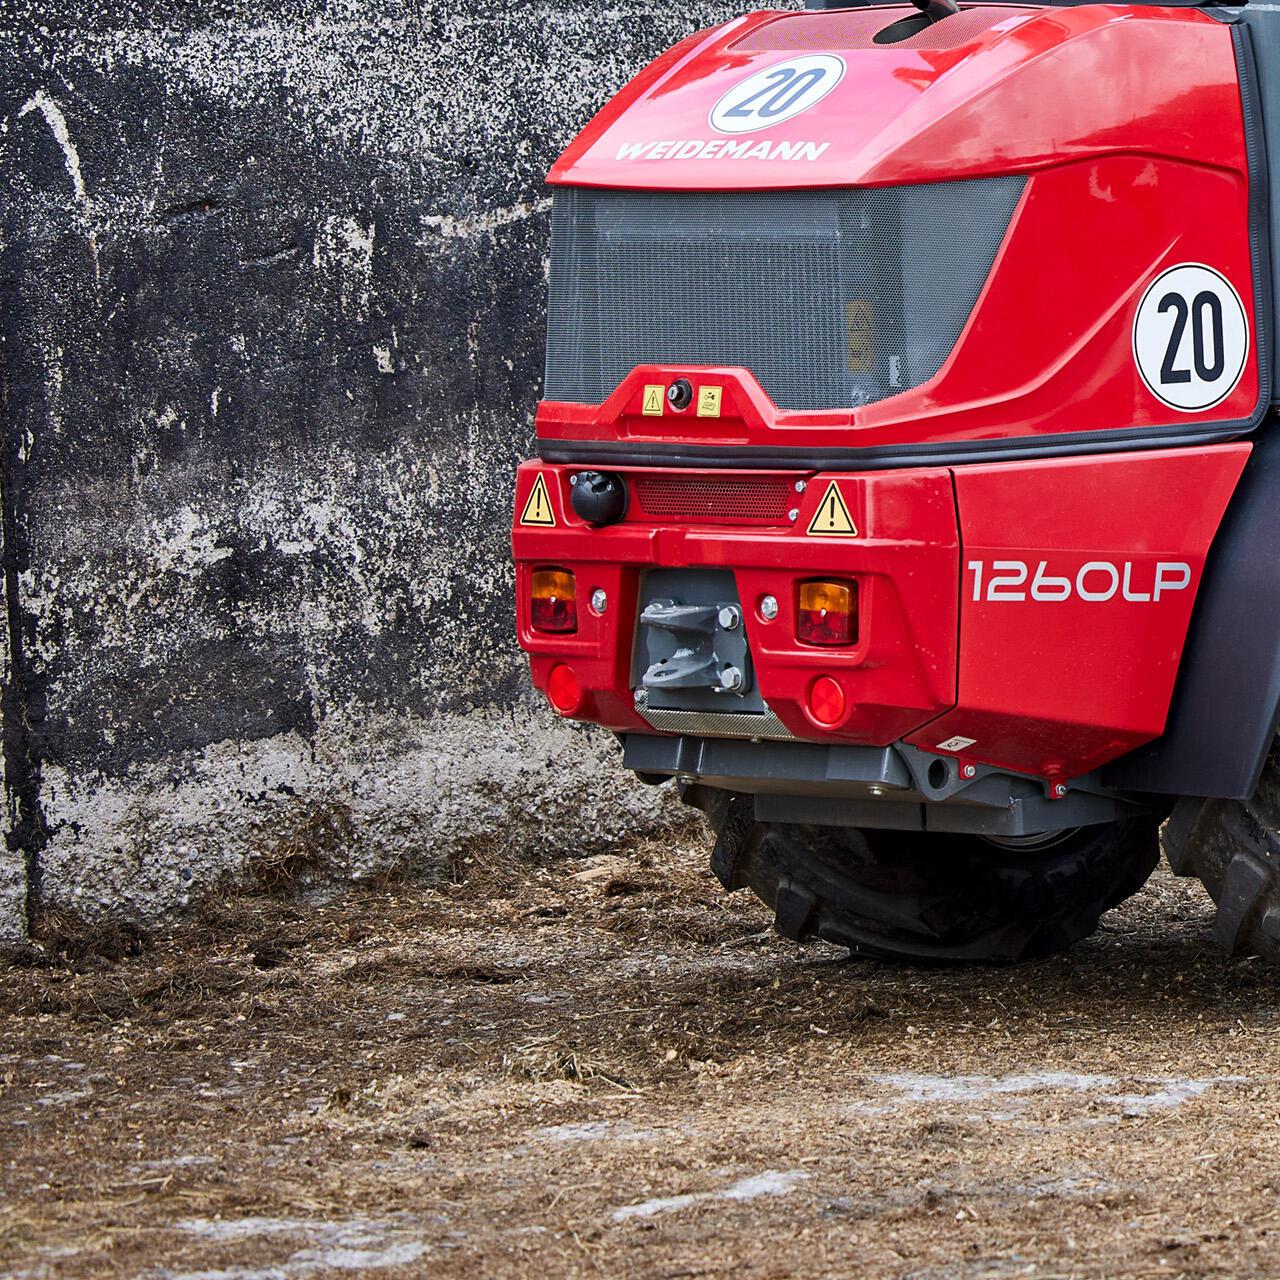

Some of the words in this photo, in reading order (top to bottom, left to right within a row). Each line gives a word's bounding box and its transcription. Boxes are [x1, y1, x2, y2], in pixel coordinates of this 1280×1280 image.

[722, 68, 826, 118] 20
[615, 140, 831, 161] WEIDEMANN
[1157, 290, 1225, 384] 20
[968, 561, 1192, 602] 1260LP
